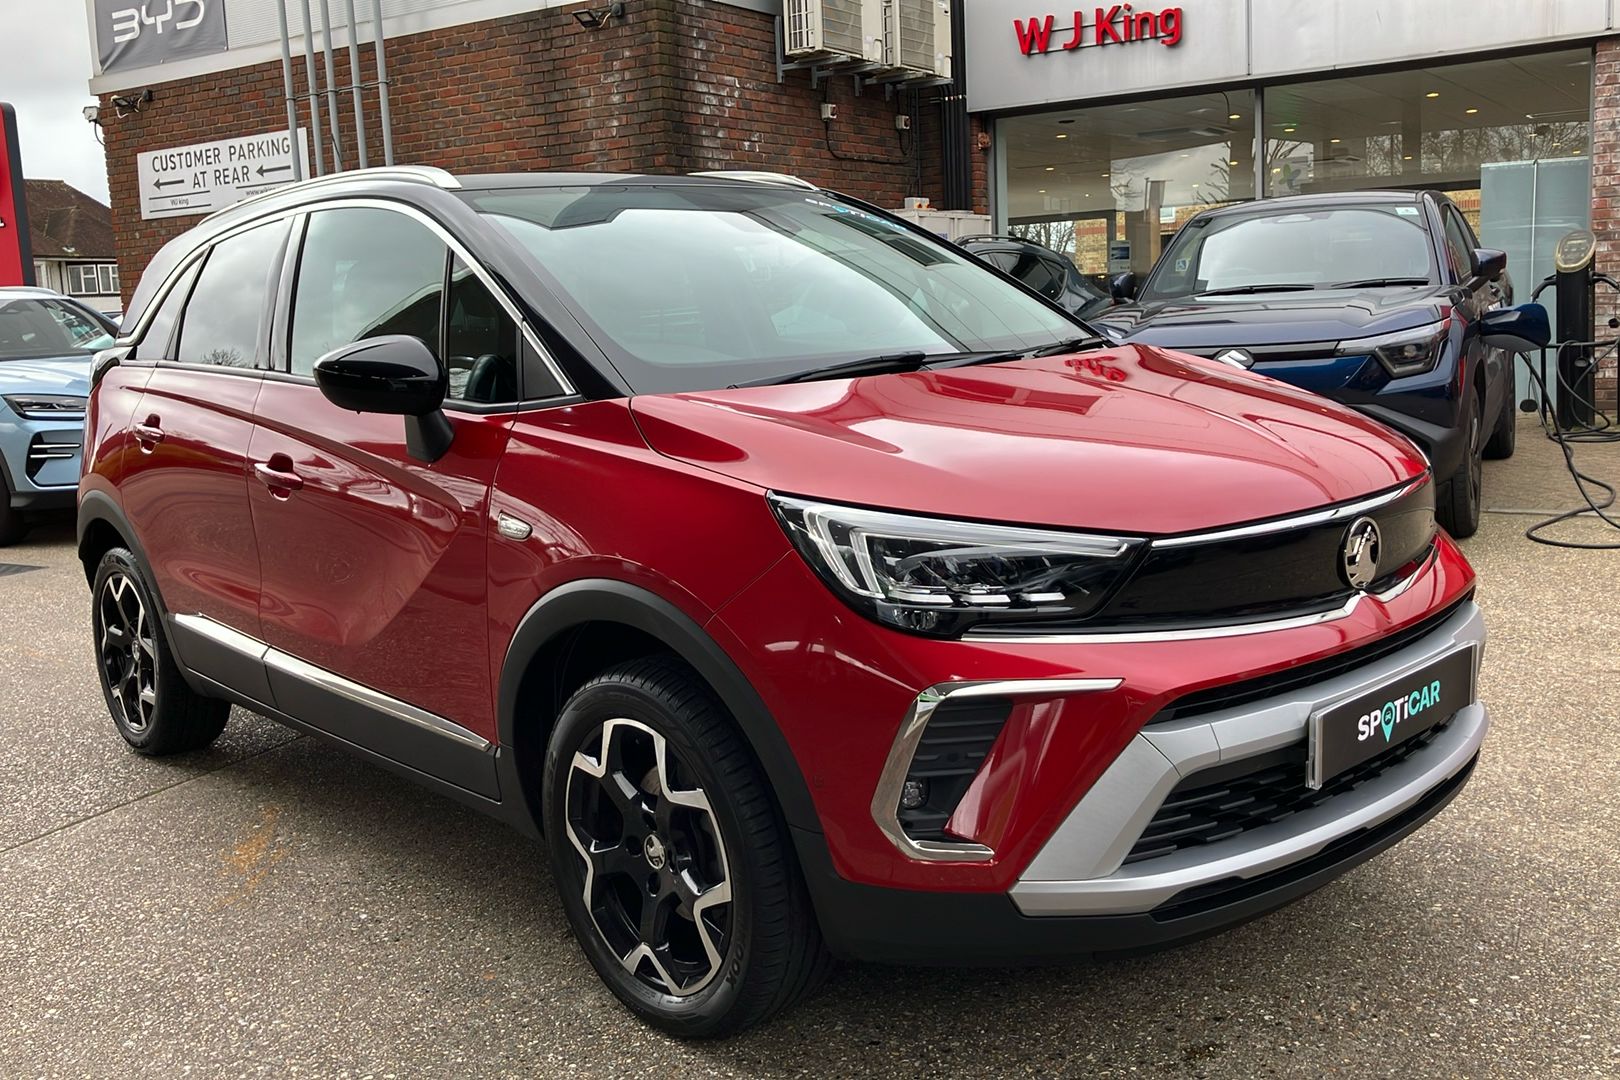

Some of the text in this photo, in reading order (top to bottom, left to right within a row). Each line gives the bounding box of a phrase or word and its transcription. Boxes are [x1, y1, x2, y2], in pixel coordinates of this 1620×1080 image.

[111, 0, 205, 43] BYD
[1013, 3, 1183, 56] W J King
[152, 137, 290, 172] CUSTOMER PARKING
[193, 165, 250, 189] AT REAR
